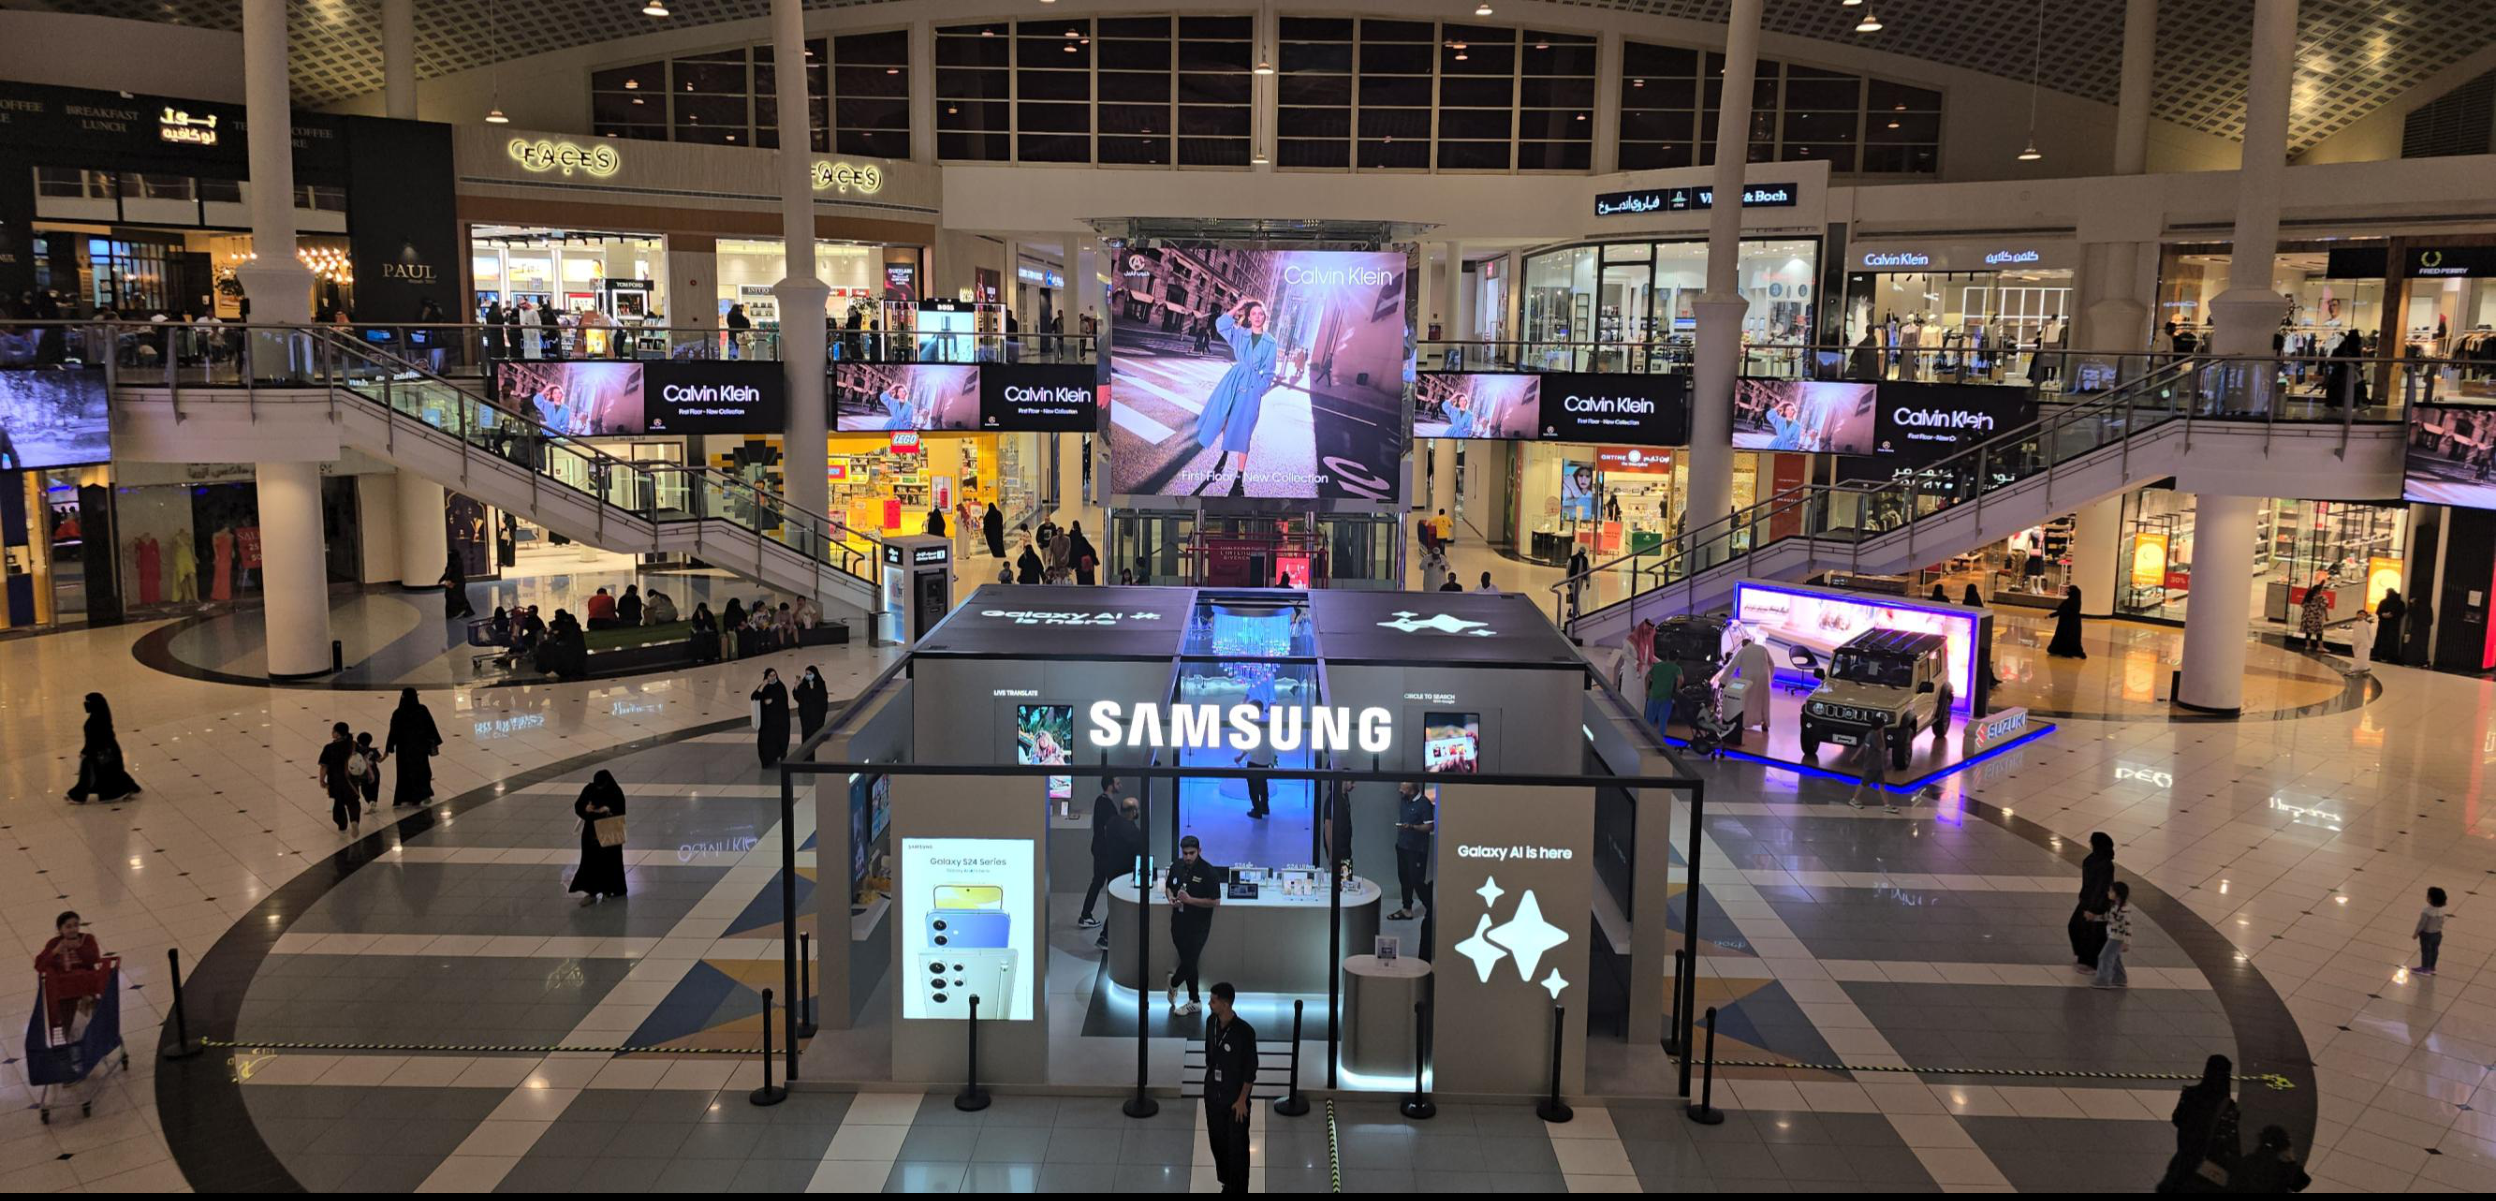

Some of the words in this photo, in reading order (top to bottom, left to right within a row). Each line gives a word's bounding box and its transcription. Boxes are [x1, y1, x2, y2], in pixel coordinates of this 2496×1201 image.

[0, 98, 45, 113] OFFEE
[65, 104, 140, 121] BREAKFAST
[82, 119, 127, 132] LUNCH
[291, 126, 334, 139] COFFEE
[514, 142, 616, 173] FACES
[1743, 192, 1754, 203] &
[1754, 189, 1788, 203] Boch
[1864, 253, 1900, 266] Calvin
[1901, 253, 1929, 266] Klein
[382, 263, 437, 279] PAUL
[1284, 265, 1344, 286] Calvin
[1348, 265, 1393, 286] Klein
[2418, 267, 2440, 275] FRED
[2441, 267, 2468, 275] PERRY
[663, 384, 718, 402] Calvin
[720, 384, 760, 402] Klein
[1004, 385, 1054, 403] Calvin
[1055, 386, 1092, 403] Klein
[1564, 395, 1615, 413] Calvin
[1617, 397, 1655, 414] Klein
[1893, 407, 1950, 427] Calvin
[1951, 410, 1994, 430] Klein
[893, 434, 918, 444] LEGO
[1181, 470, 1203, 482] First
[1206, 471, 1234, 482] Floor
[1243, 471, 1270, 483] New
[1272, 472, 1329, 484] Collection
[981, 610, 1090, 620] Galaxy
[993, 689, 1006, 697] LIVE
[1006, 689, 1038, 697] TRANSLATE
[1089, 700, 1392, 752] SAMSUNG
[1987, 711, 2027, 740] SUZUKI
[1457, 845, 1508, 861] Galaxy
[1509, 846, 1523, 858] AI
[1526, 845, 1538, 859] is
[1539, 846, 1573, 859] here
[930, 857, 962, 867] Galaxy
[979, 857, 1007, 865] Series
